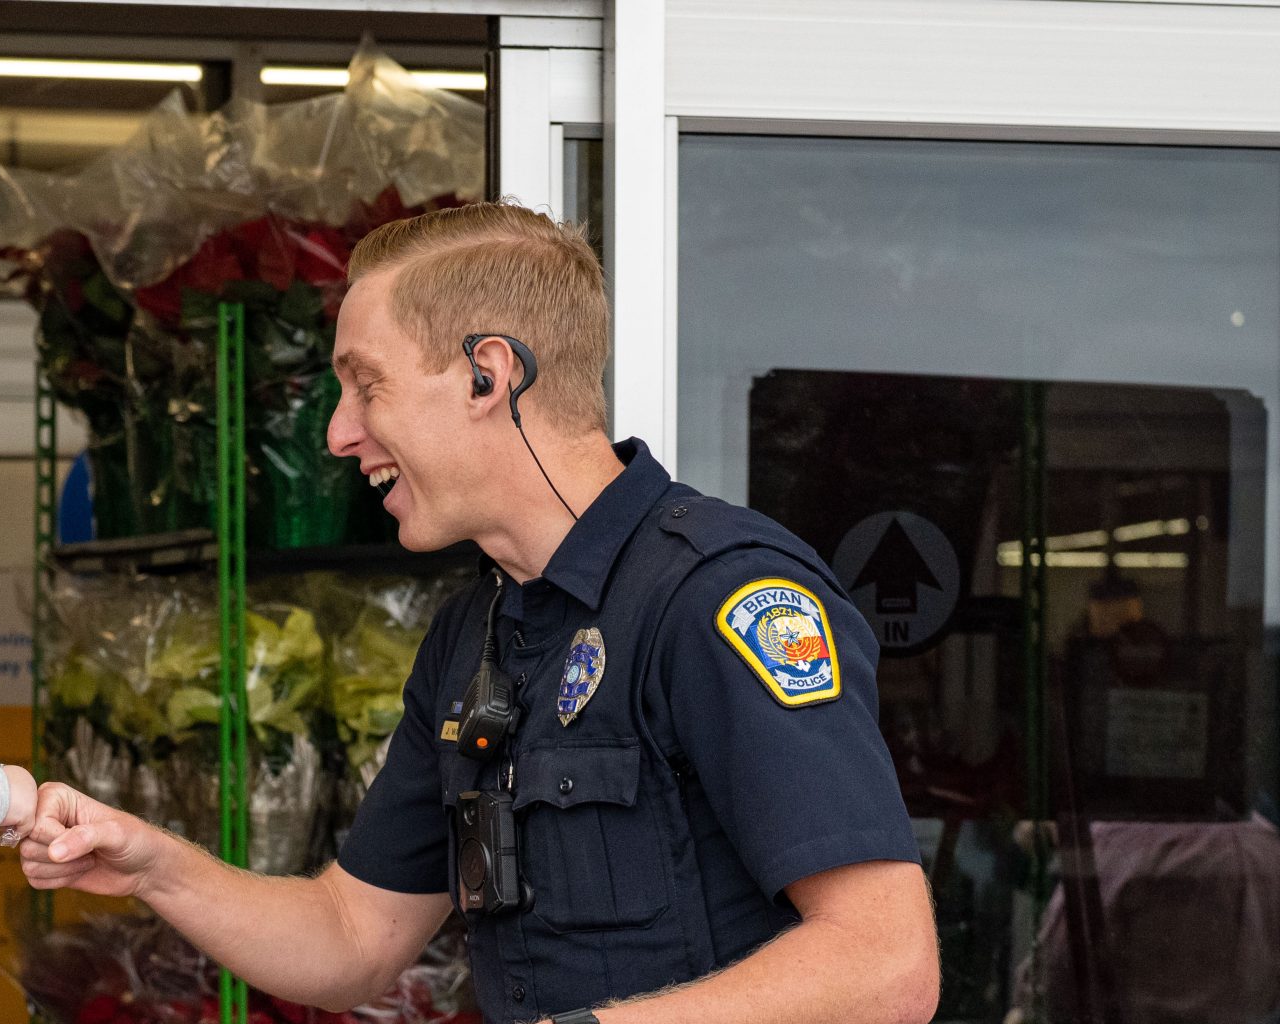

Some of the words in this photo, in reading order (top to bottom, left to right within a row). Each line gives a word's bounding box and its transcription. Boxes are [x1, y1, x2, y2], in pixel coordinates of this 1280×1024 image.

[742, 590, 802, 615] BRYAN
[766, 606, 794, 620] 1871
[884, 621, 909, 642] IN
[787, 672, 827, 687] POLICE
